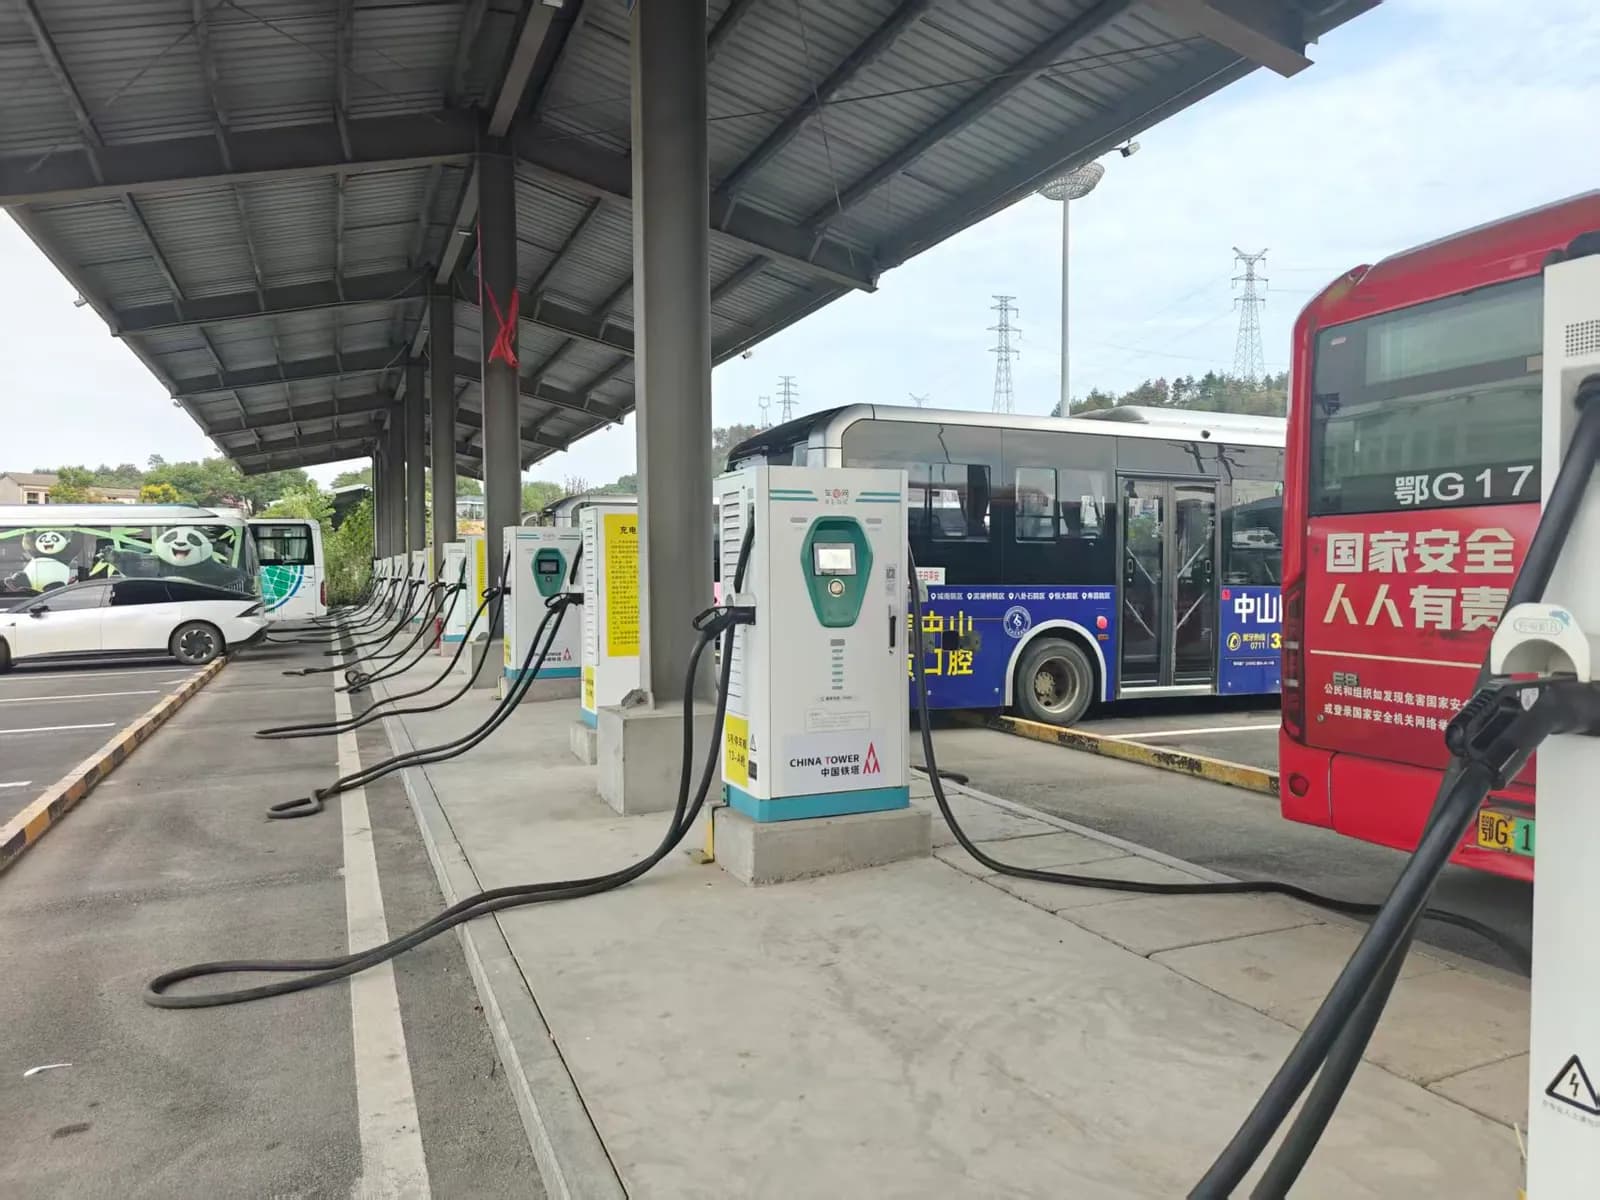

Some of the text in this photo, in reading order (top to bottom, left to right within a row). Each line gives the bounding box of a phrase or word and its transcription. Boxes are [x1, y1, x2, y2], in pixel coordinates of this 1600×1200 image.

[1394, 465, 1533, 505] 鄂G17
[1326, 527, 1516, 574] 国家安全
[1233, 592, 1283, 623] 中山
[1322, 583, 1511, 632] 人人有责
[1250, 641, 1265, 650] 0711
[1271, 632, 1282, 649] 3
[789, 753, 860, 768] CHINA TOWER
[820, 765, 860, 777] 中国铁塔
